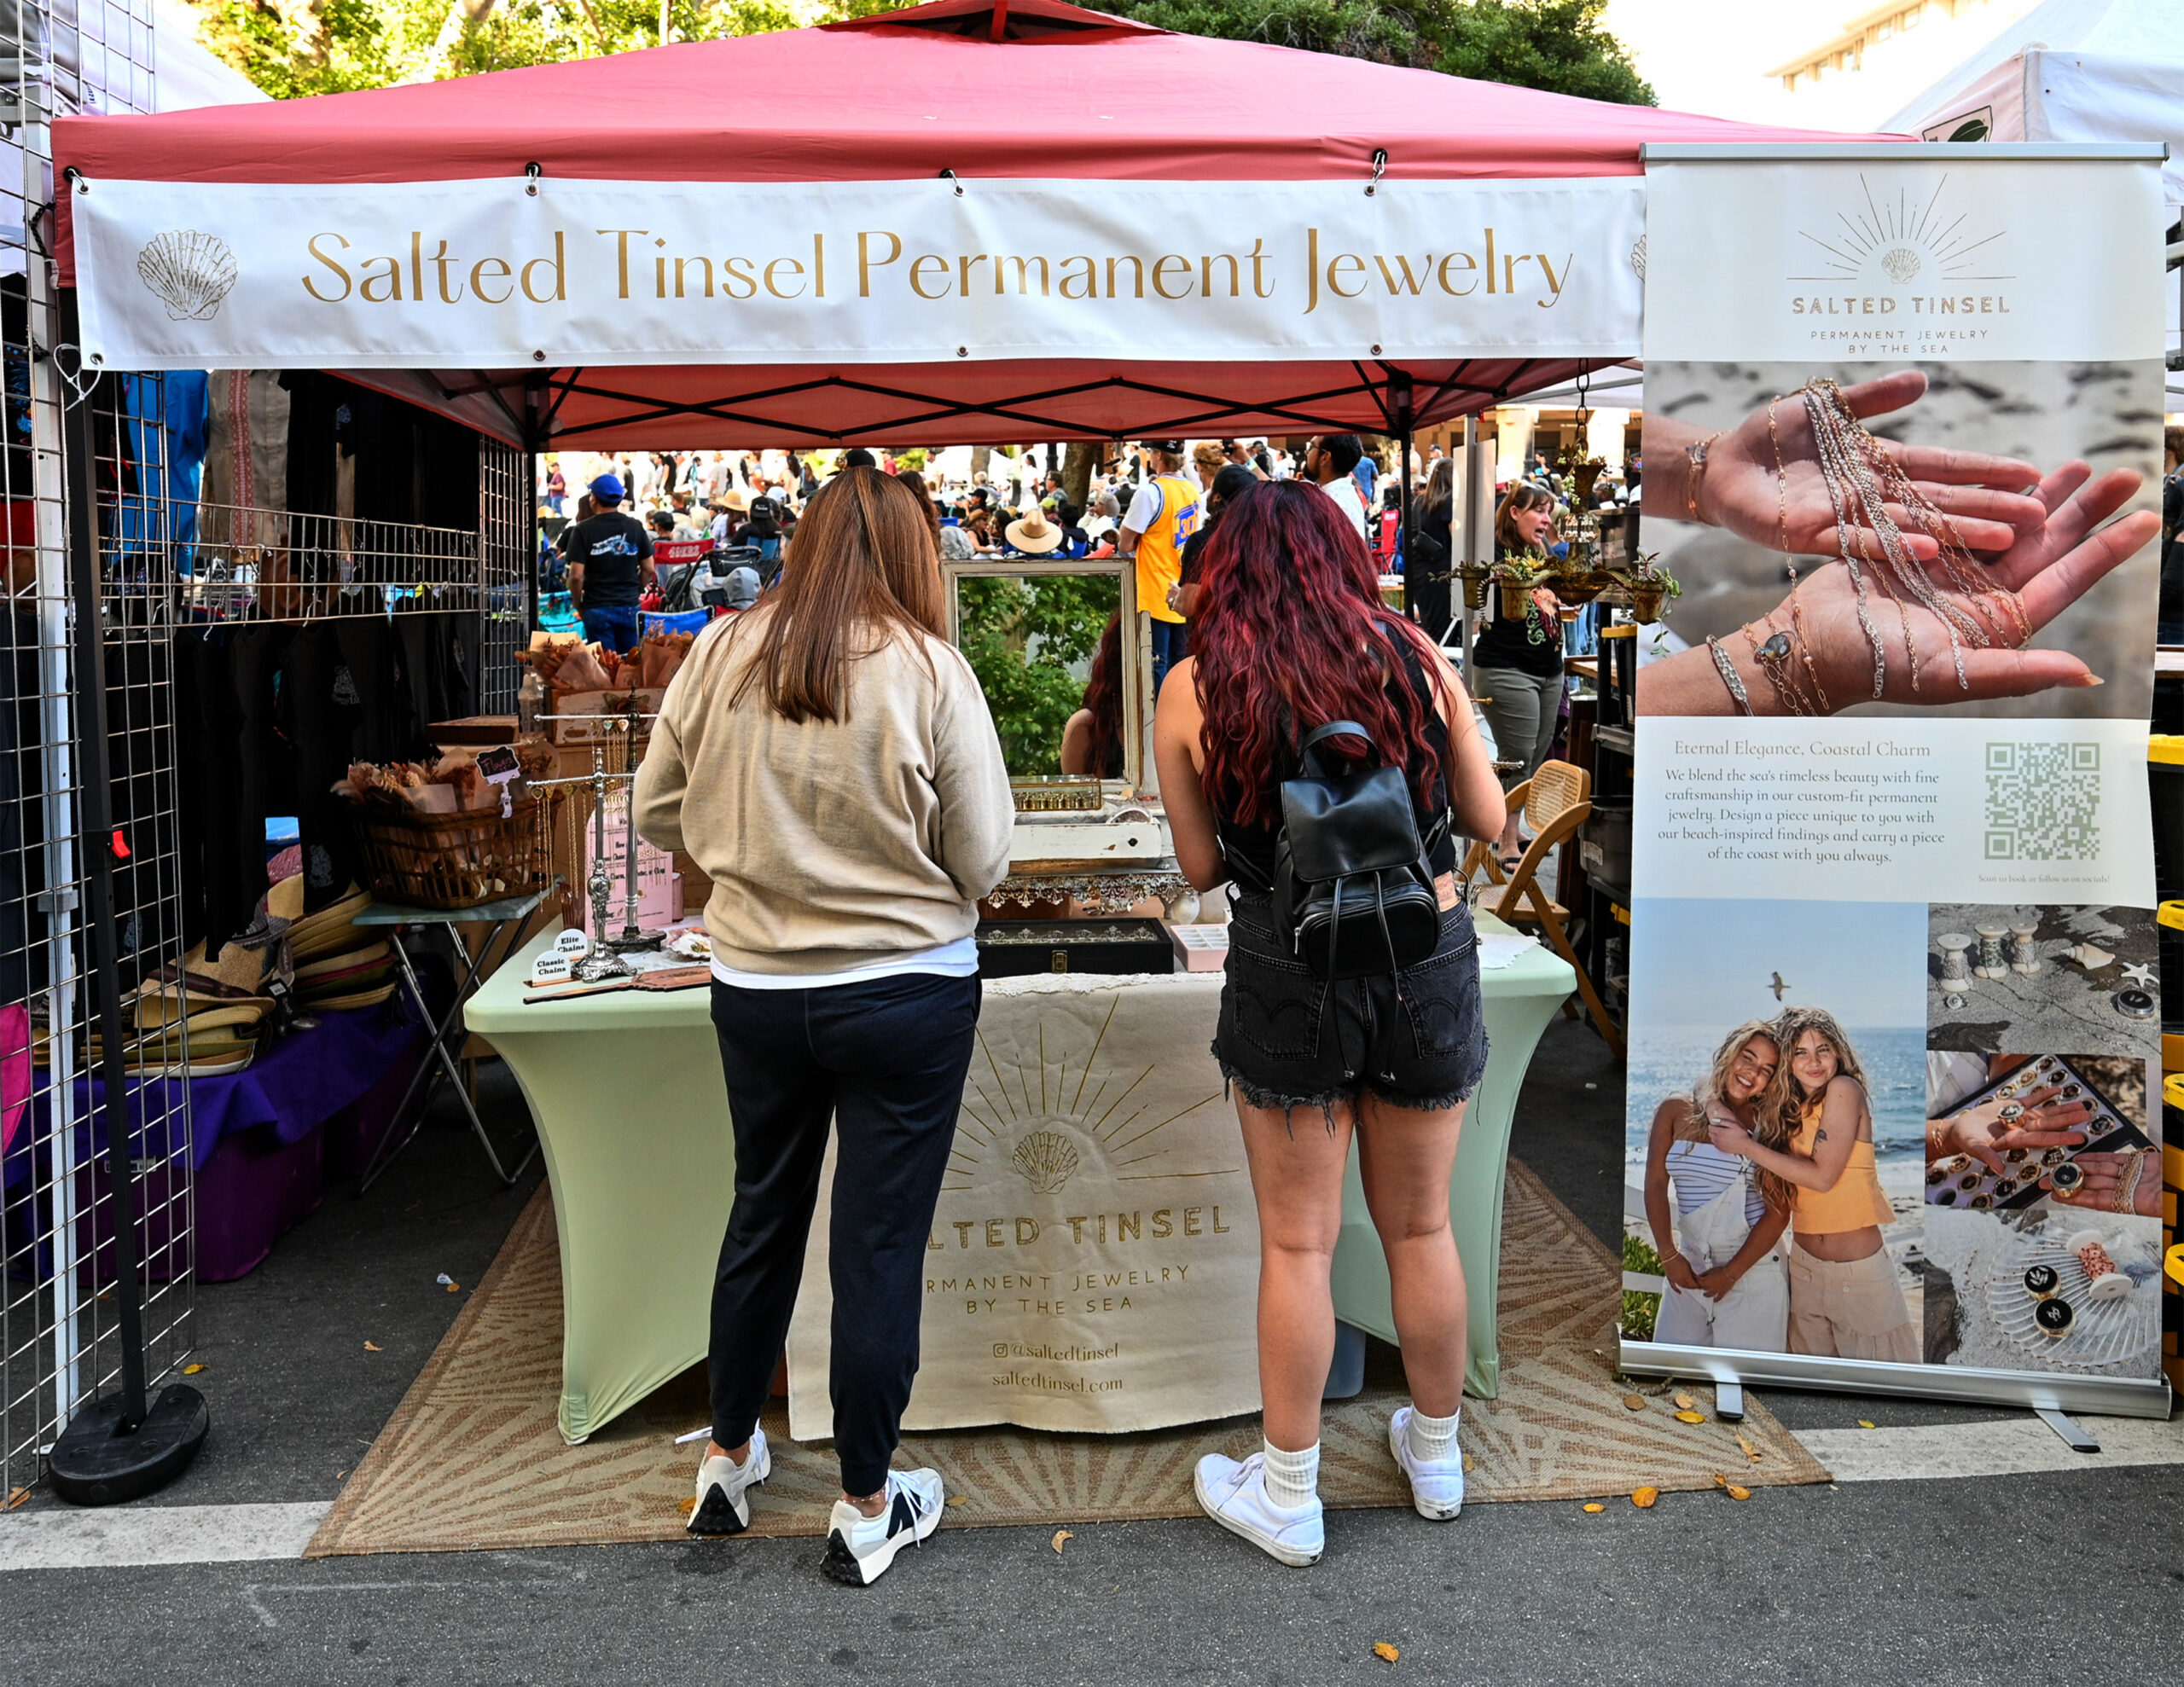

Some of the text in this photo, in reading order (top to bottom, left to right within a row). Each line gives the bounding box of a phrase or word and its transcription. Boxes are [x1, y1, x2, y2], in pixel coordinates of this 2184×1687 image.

[301, 228, 1573, 315] Salted Tinsel Permanent Jewelry
[1792, 297, 2010, 314] SALTED TINSEL
[1811, 330, 1988, 339] PERMANENT JEWELRY
[1181, 515, 1196, 538] 30
[1675, 740, 1931, 759] Eternal Elegance, Coastal Charm
[1665, 769, 1939, 786] We blend the sea's timeless beauty with fine
[1664, 788, 1938, 805] craftsmanship in our custom-fit permanent
[1668, 809, 1716, 823] jewelry.
[1720, 809, 1762, 824] Design
[1777, 810, 1809, 824] piece
[1813, 812, 1857, 826] unique
[1879, 815, 1902, 826] you
[1906, 811, 1934, 823] with
[1658, 830, 1679, 838] our
[1682, 828, 1773, 843] beach-inspired
[1778, 828, 1829, 844] findings
[1833, 831, 1858, 842] and
[1862, 832, 1896, 845] carry
[1913, 832, 1945, 846] piece
[1708, 847, 1891, 865] of the coast with you always.
[537, 959, 565, 967] Classic
[927, 1206, 1230, 1250] LTED TINSEL
[927, 1266, 1189, 1293] RMANENT JEWELRY
[967, 1298, 1132, 1315] BY THE SEA
[1012, 1343, 1118, 1360] @saltedtinsel
[993, 1371, 1123, 1393] saltedtinsel.com
